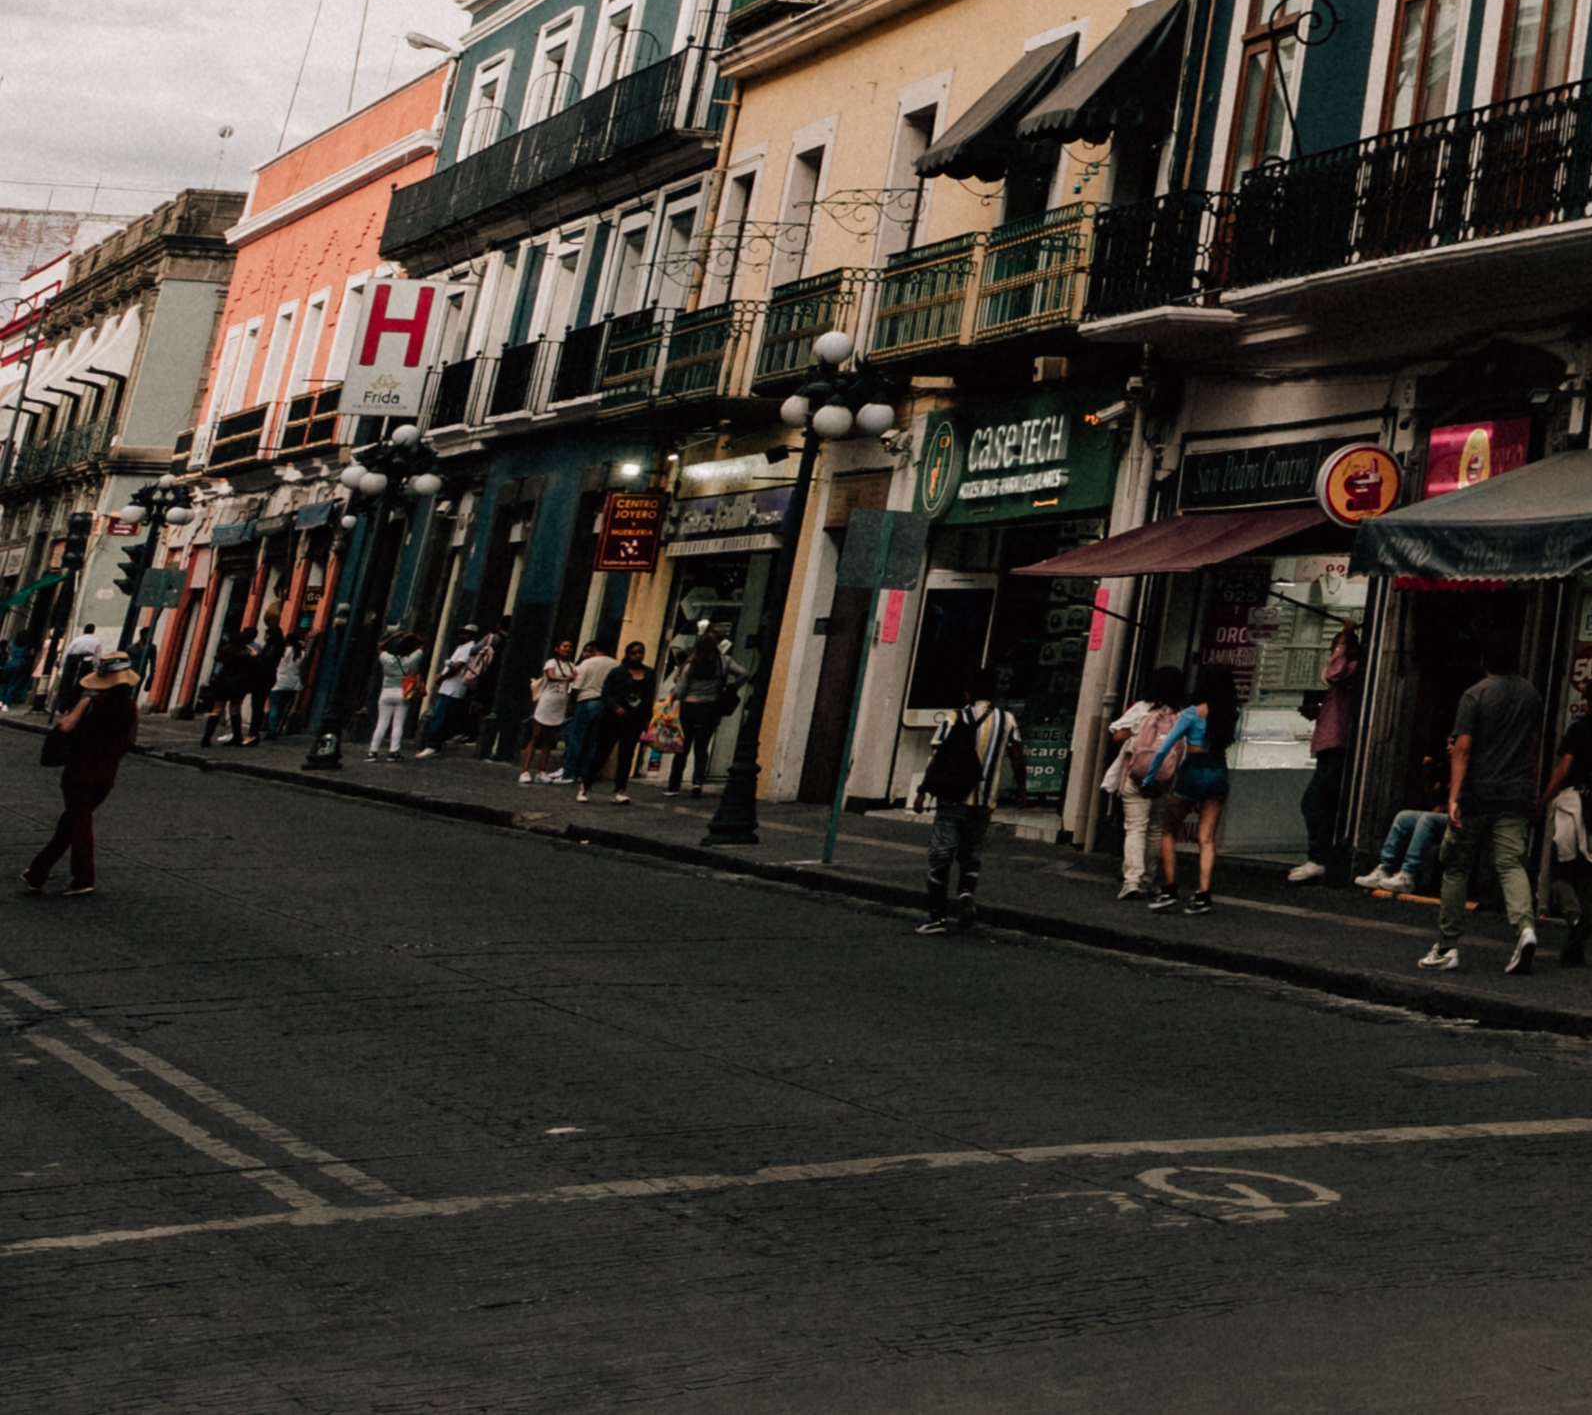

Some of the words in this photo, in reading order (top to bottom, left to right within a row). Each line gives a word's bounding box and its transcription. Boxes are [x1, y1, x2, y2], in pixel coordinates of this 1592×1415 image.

[359, 284, 435, 368] H
[363, 389, 400, 404] Frida
[1193, 457, 1218, 495] San
[1220, 450, 1260, 491] Pedro
[1261, 450, 1310, 488] Centro
[616, 499, 659, 508] CENTRO
[614, 510, 657, 519] JOYERO
